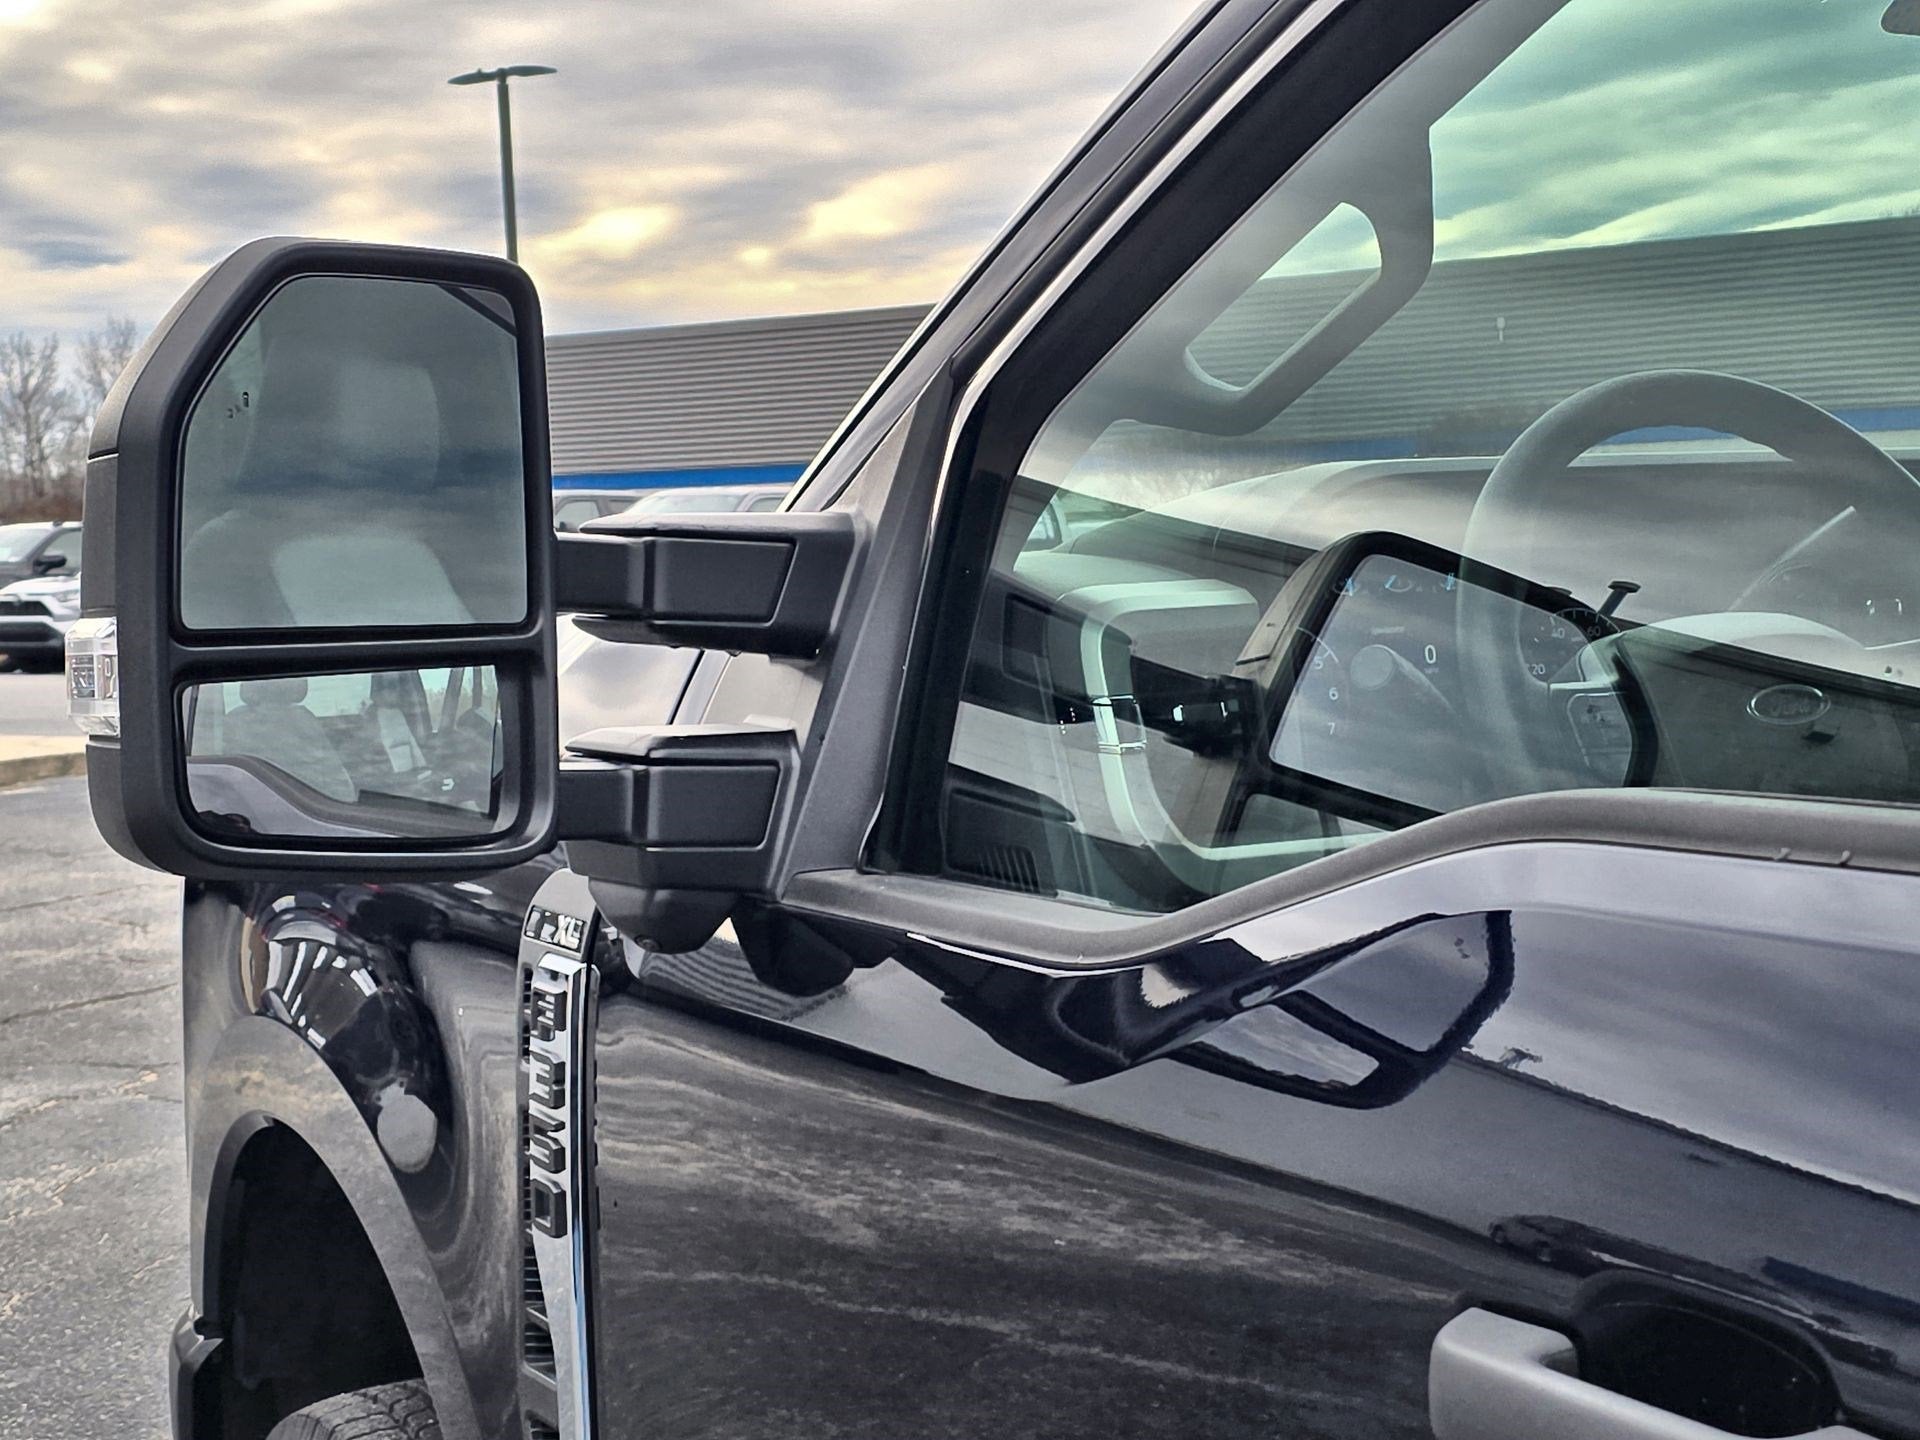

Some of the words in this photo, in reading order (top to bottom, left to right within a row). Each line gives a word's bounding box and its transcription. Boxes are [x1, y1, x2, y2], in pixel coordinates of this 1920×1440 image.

[1424, 644, 1437, 665] 0
[1328, 687, 1339, 701] 6
[1327, 722, 1336, 735] 7
